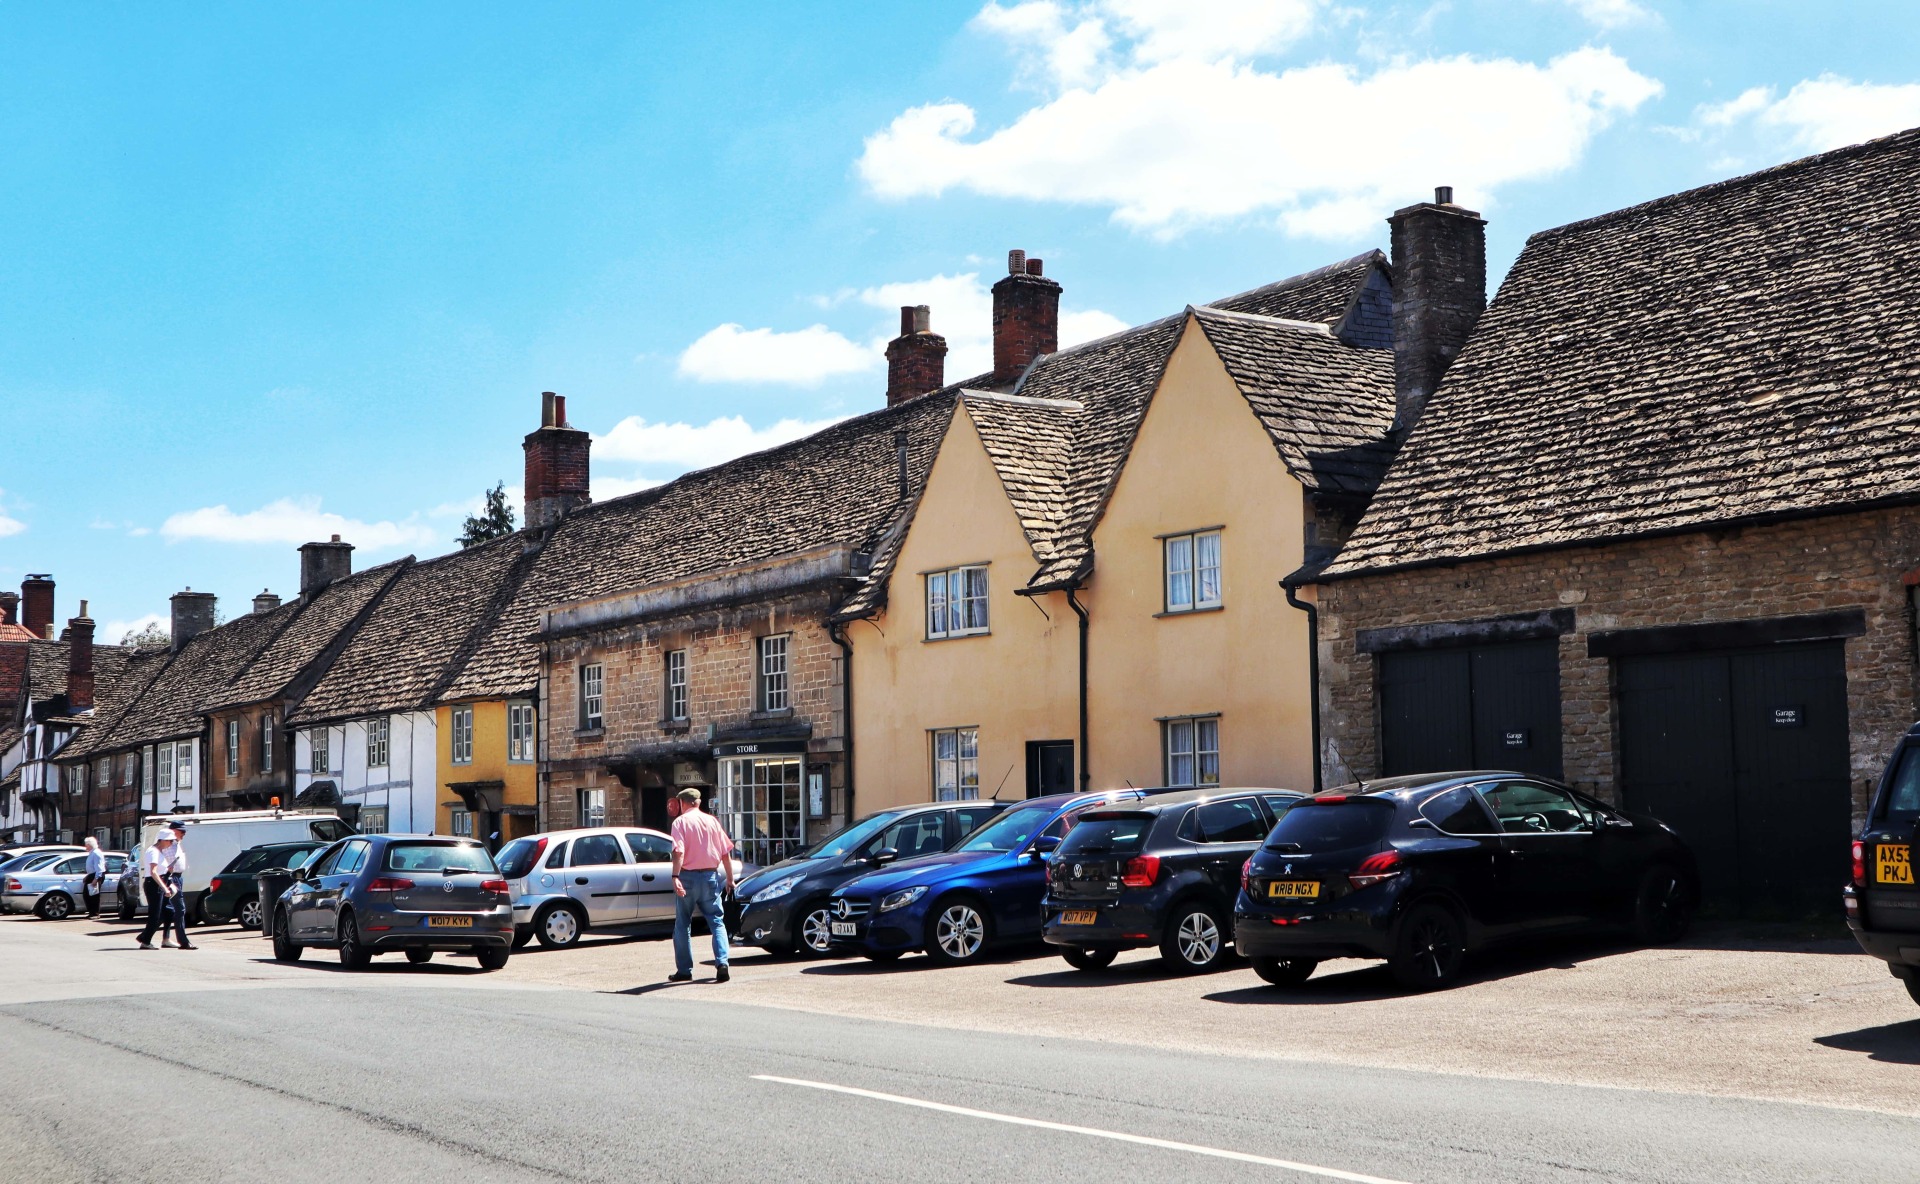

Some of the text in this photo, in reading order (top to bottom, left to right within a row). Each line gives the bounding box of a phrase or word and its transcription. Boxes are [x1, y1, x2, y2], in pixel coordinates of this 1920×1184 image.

[736, 745, 758, 753] STORE
[1880, 846, 1910, 862] AX53
[1884, 866, 1908, 882] PKJ
[1274, 884, 1314, 895] WR18 NGX
[452, 916, 469, 926] KYK
[1080, 912, 1094, 921] VPY
